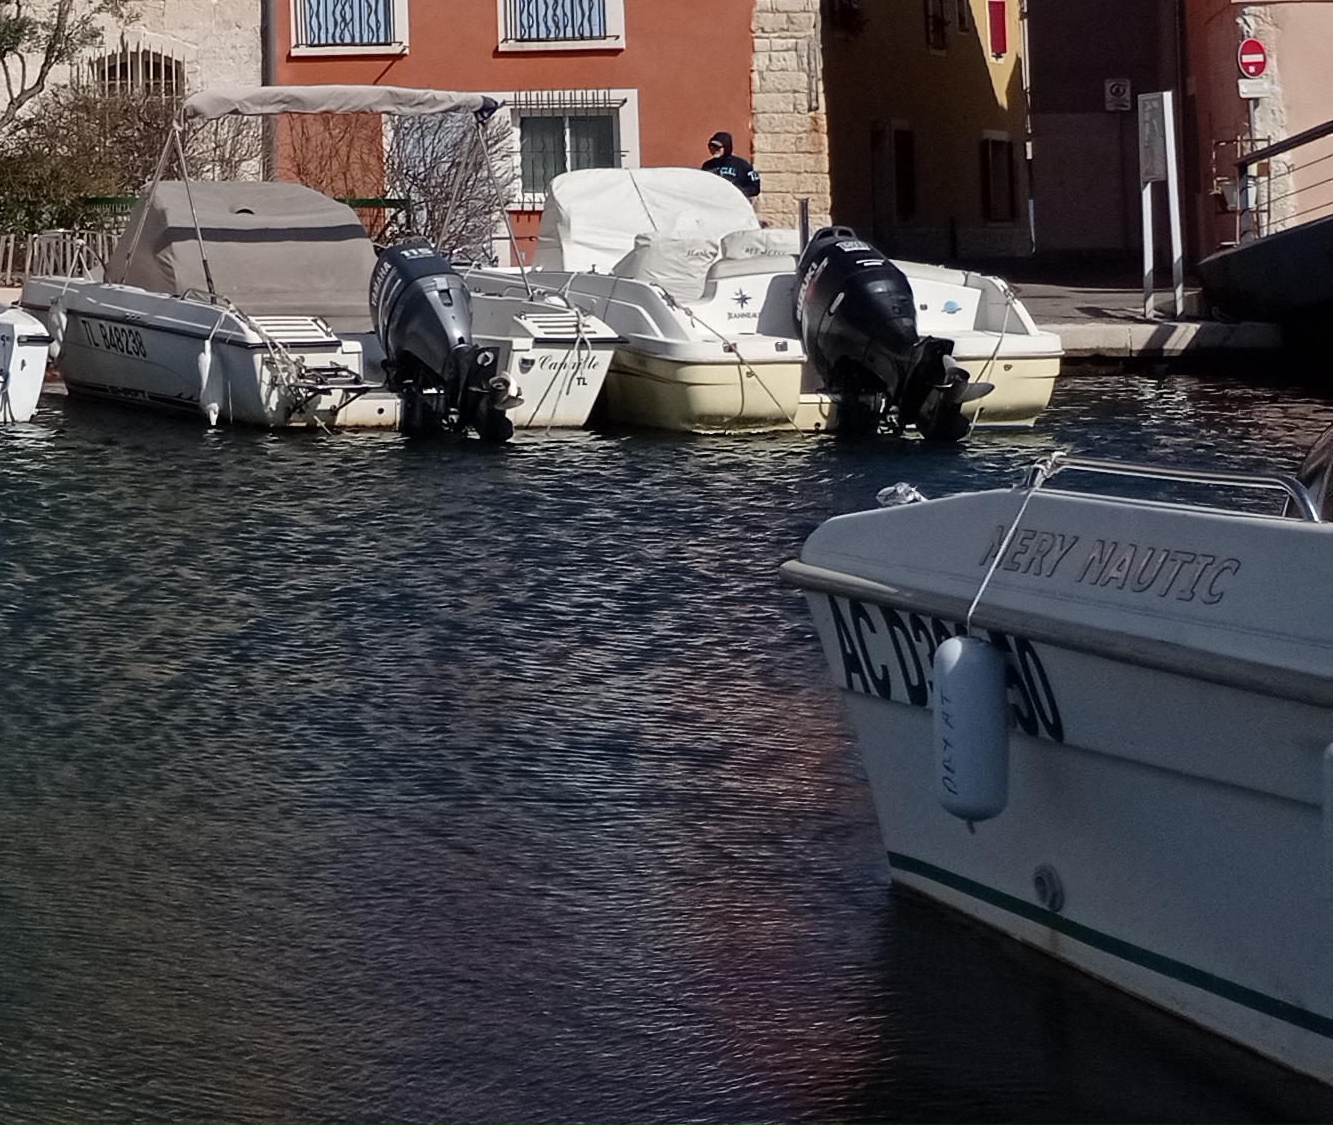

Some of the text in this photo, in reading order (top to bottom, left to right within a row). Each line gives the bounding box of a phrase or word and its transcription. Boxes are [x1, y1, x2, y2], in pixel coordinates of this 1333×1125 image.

[371, 261, 392, 307] YAMAHA
[796, 261, 818, 322] SUZUKI
[99, 322, 147, 358] B48238
[576, 376, 588, 387] TL
[1076, 539, 1241, 605] NAUTIC
[827, 595, 891, 700] AC
